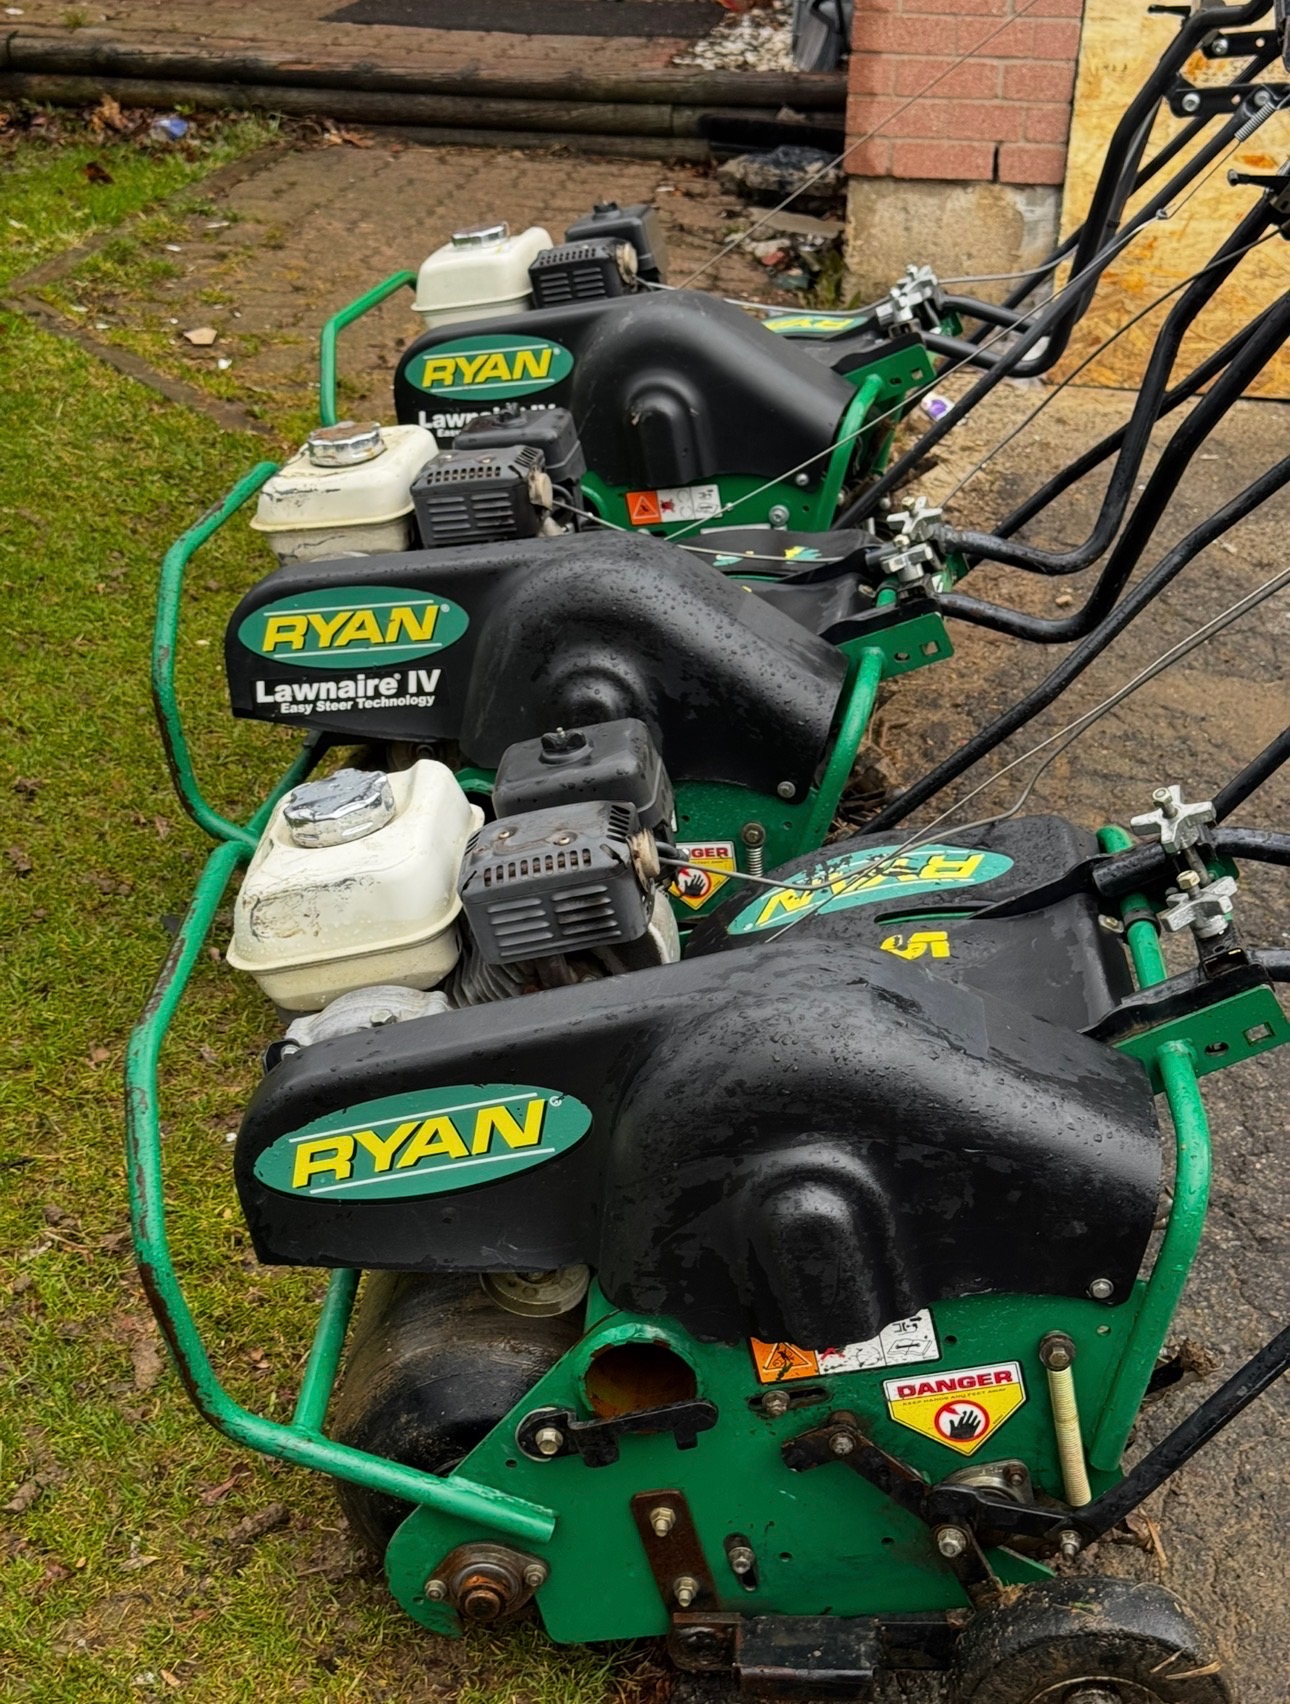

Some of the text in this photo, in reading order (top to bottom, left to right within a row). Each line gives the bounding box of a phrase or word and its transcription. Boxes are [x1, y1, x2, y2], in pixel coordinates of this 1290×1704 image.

[421, 348, 553, 389] RYAN
[262, 604, 440, 652] RYAN
[408, 669, 441, 694] IV
[280, 695, 435, 716] Easy Steer Technology
[690, 847, 729, 858] GER
[292, 1099, 546, 1189] RYAN
[897, 1370, 1012, 1398] DANGER
